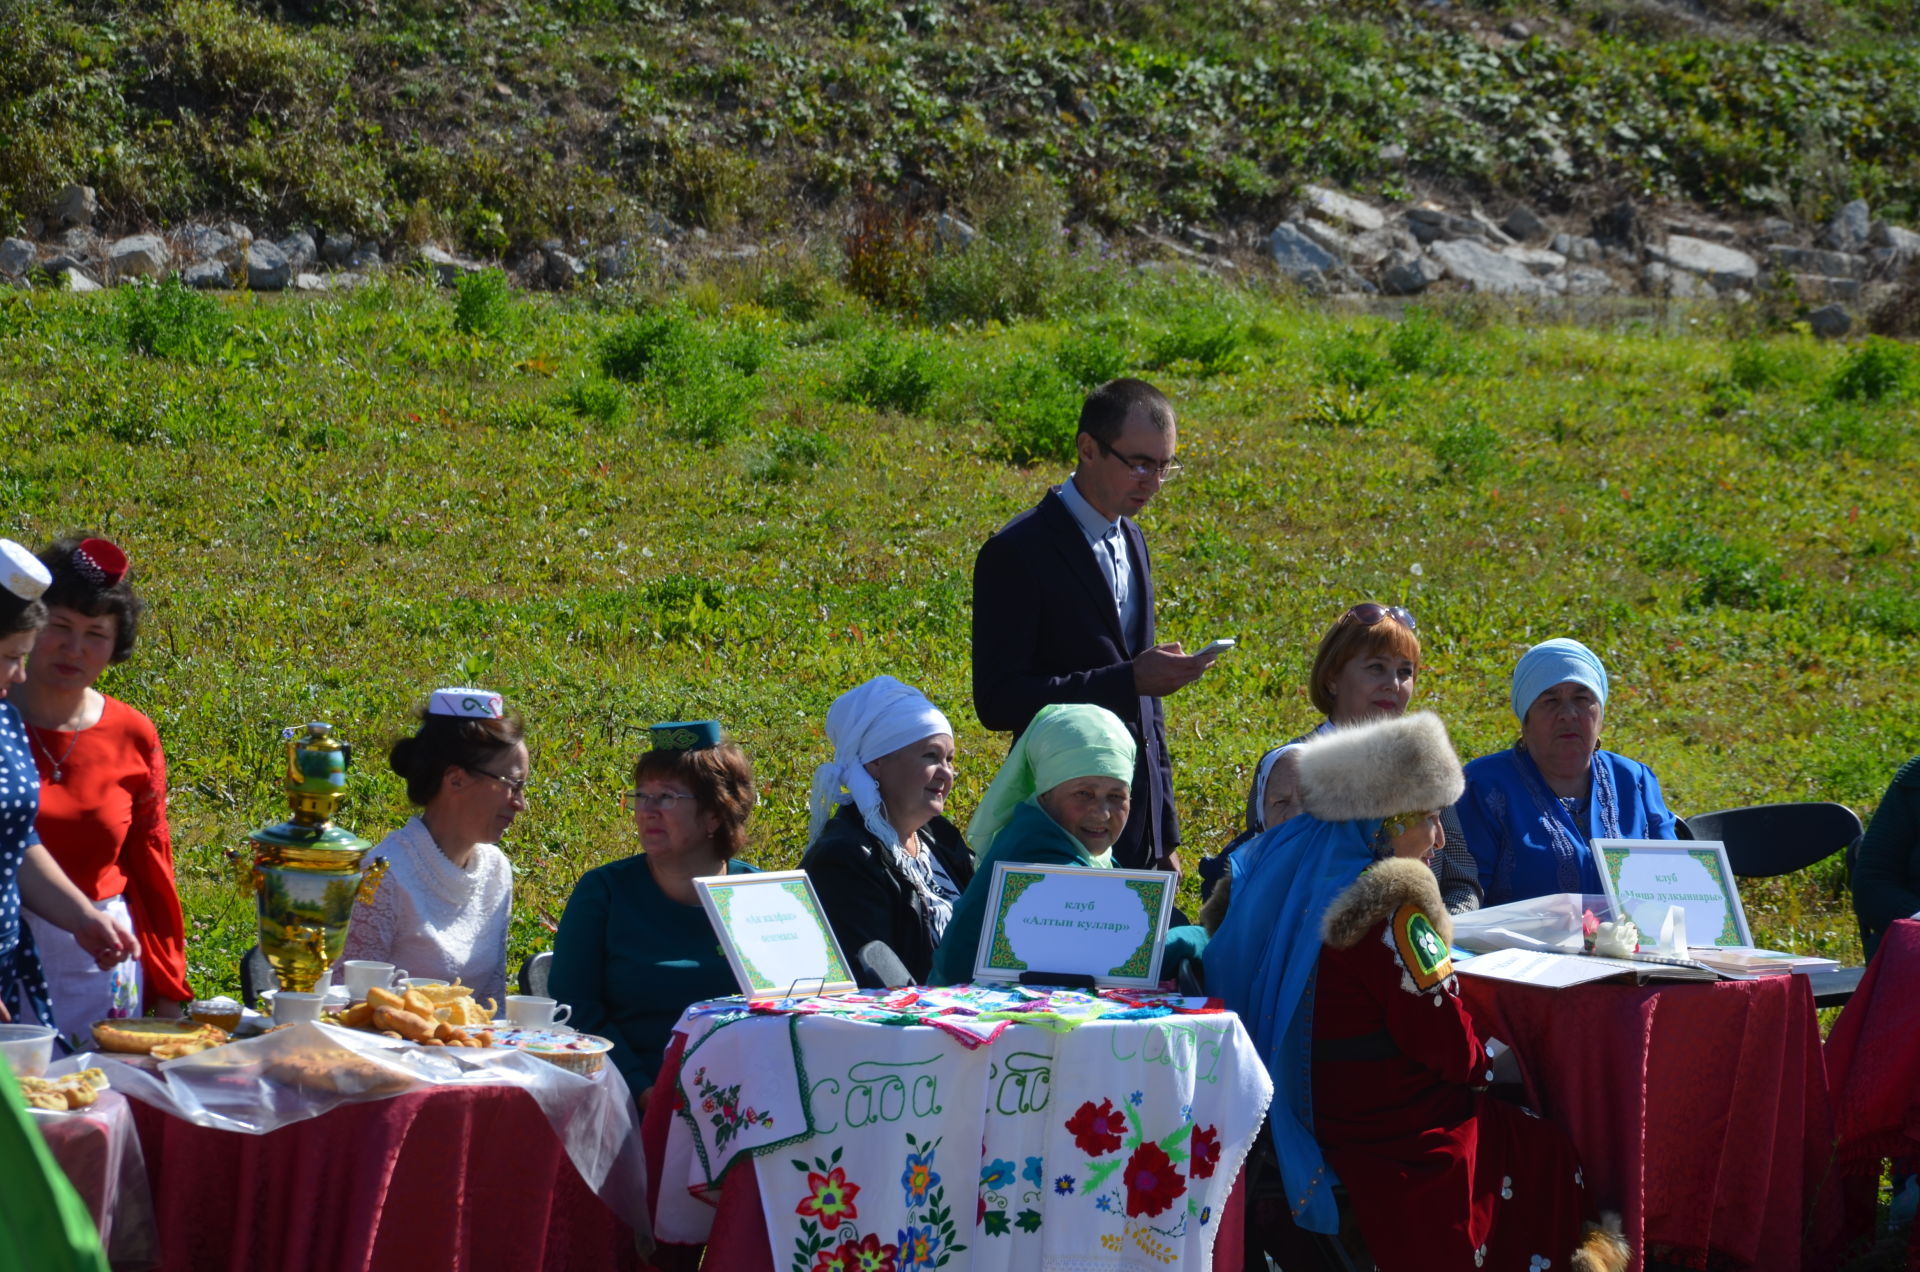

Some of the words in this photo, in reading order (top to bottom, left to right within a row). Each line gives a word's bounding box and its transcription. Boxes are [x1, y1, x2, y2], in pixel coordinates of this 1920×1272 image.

[1655, 872, 1678, 884] клуб
[1064, 901, 1095, 912] клуб
[1023, 916, 1073, 928] «Алтын
[1077, 920, 1130, 933] куллар»
